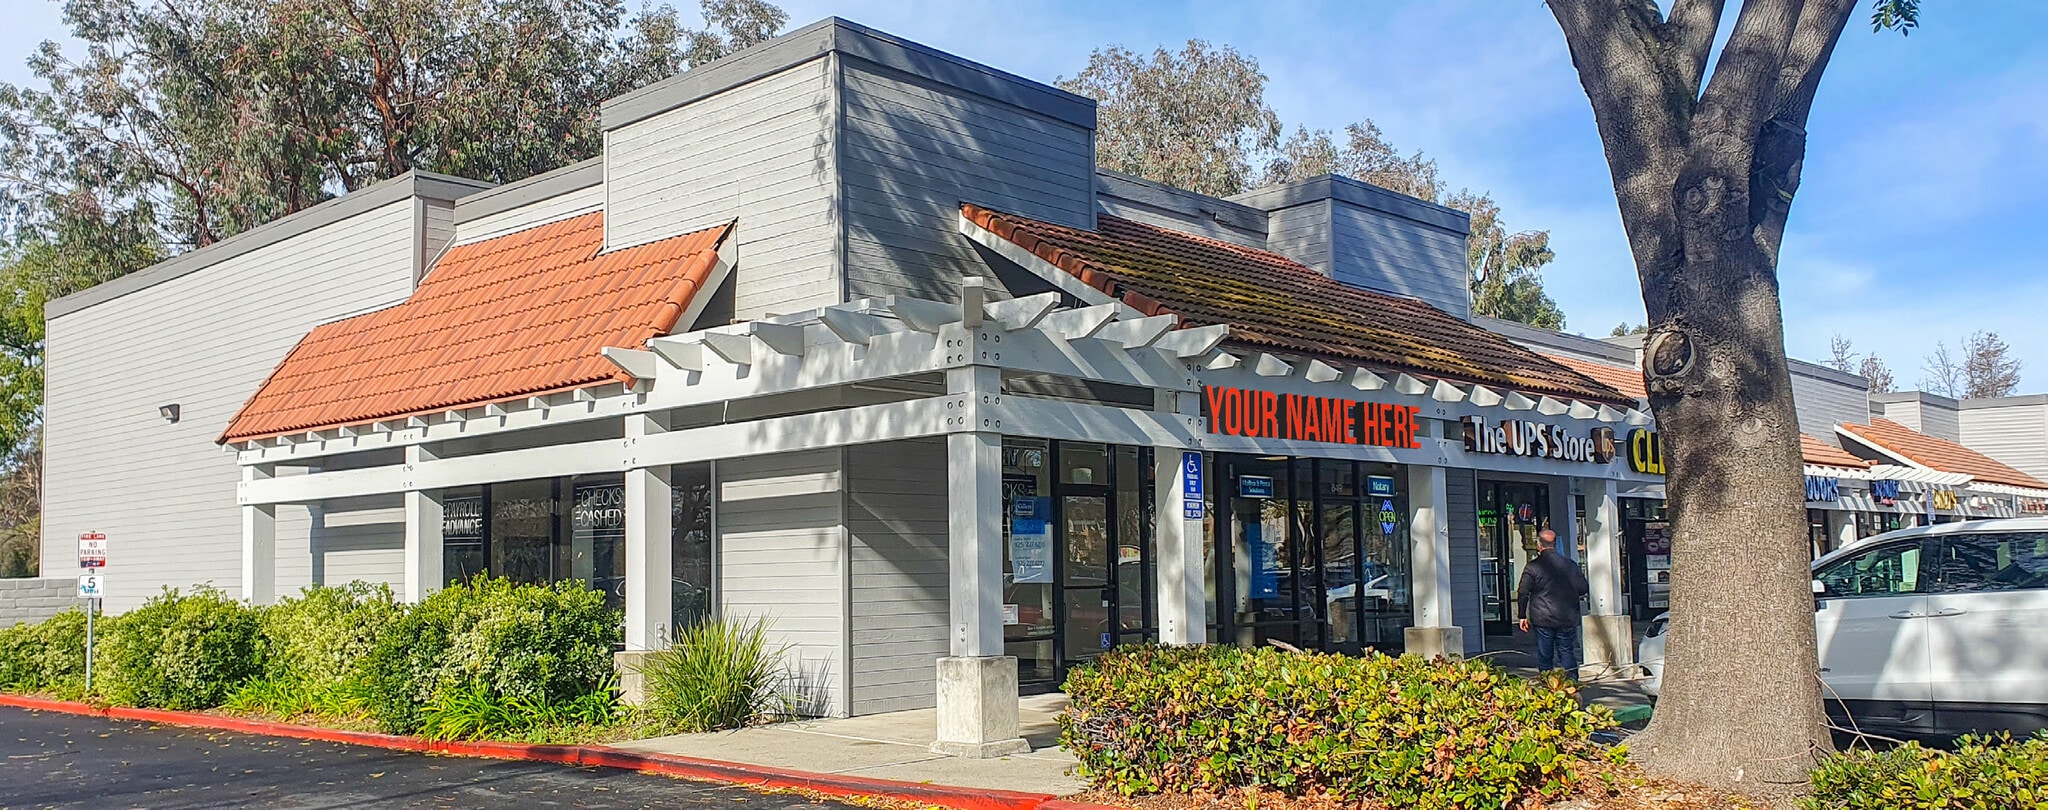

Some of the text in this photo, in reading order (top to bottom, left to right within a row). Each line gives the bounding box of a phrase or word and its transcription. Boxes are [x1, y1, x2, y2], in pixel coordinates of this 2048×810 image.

[1472, 416, 1595, 463] The UPS Store
[1002, 482, 1026, 500] CKS
[1373, 481, 1390, 493] Notary
[1805, 476, 1839, 501] QUORS
[581, 487, 622, 507] CHECKS
[446, 501, 479, 518] PAYROLL
[580, 508, 622, 527] CASHED
[1379, 511, 1396, 523] OPEN
[445, 519, 480, 535] ADVANCE
[88, 577, 95, 588] 5
